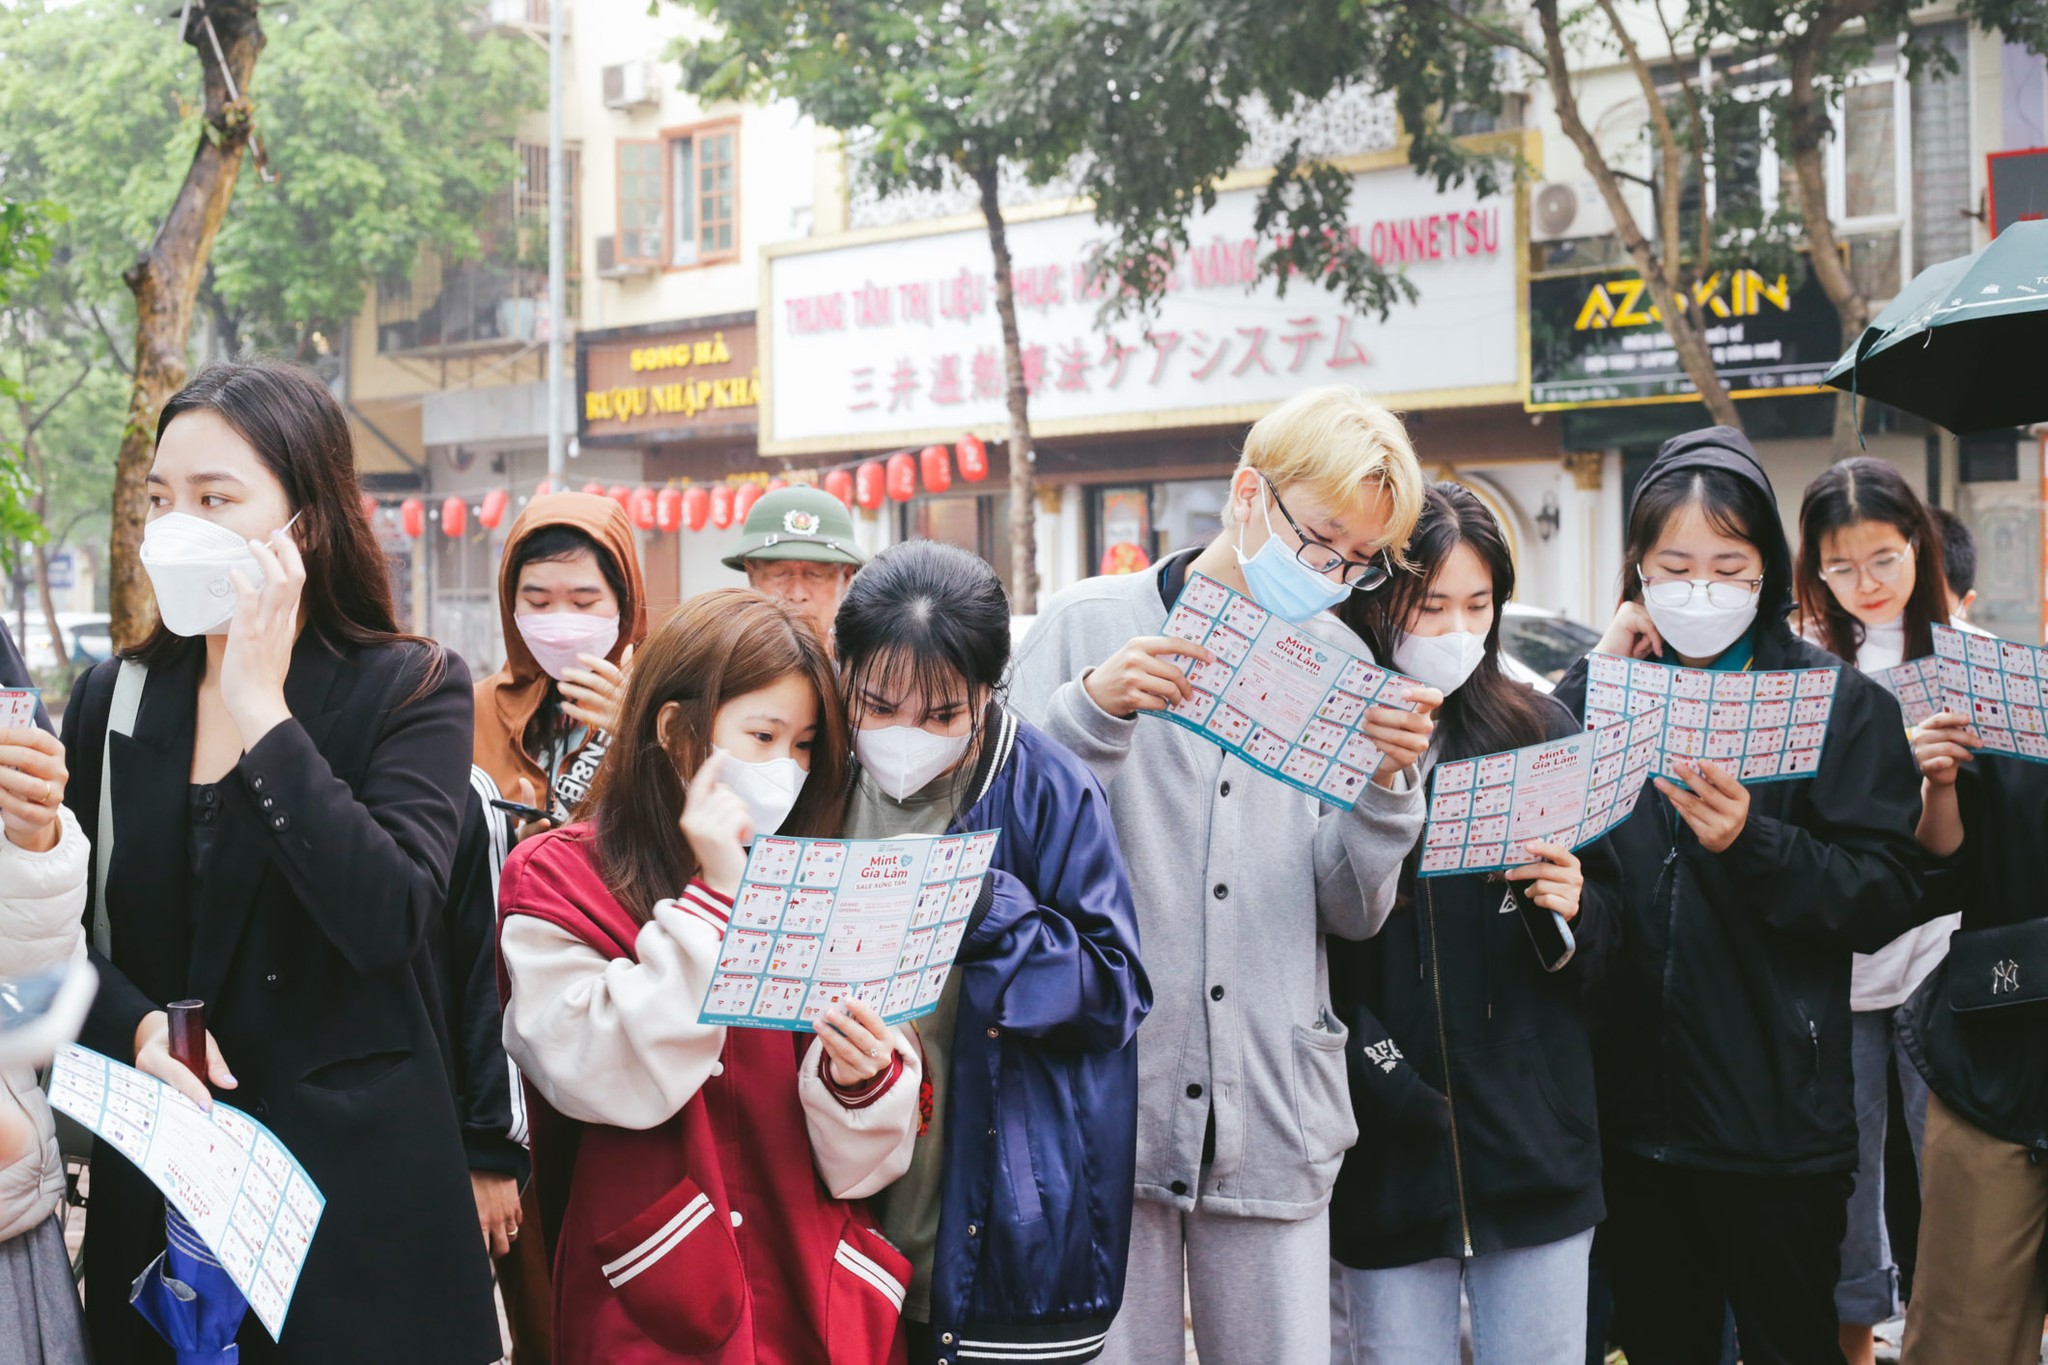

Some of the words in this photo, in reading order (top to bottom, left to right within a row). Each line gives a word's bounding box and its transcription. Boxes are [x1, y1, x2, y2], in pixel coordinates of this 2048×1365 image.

[785, 292, 844, 335] TRUNG
[1370, 207, 1499, 266] ONNETSU
[630, 343, 690, 372] SONG
[1276, 640, 1294, 656] Gia
[1285, 636, 1313, 655] Mint
[1539, 749, 1565, 762] Mint
[1532, 762, 1550, 770] Gia
[870, 855, 897, 867] Mint
[861, 867, 880, 878] Gia
[1992, 959, 2020, 994] NY
